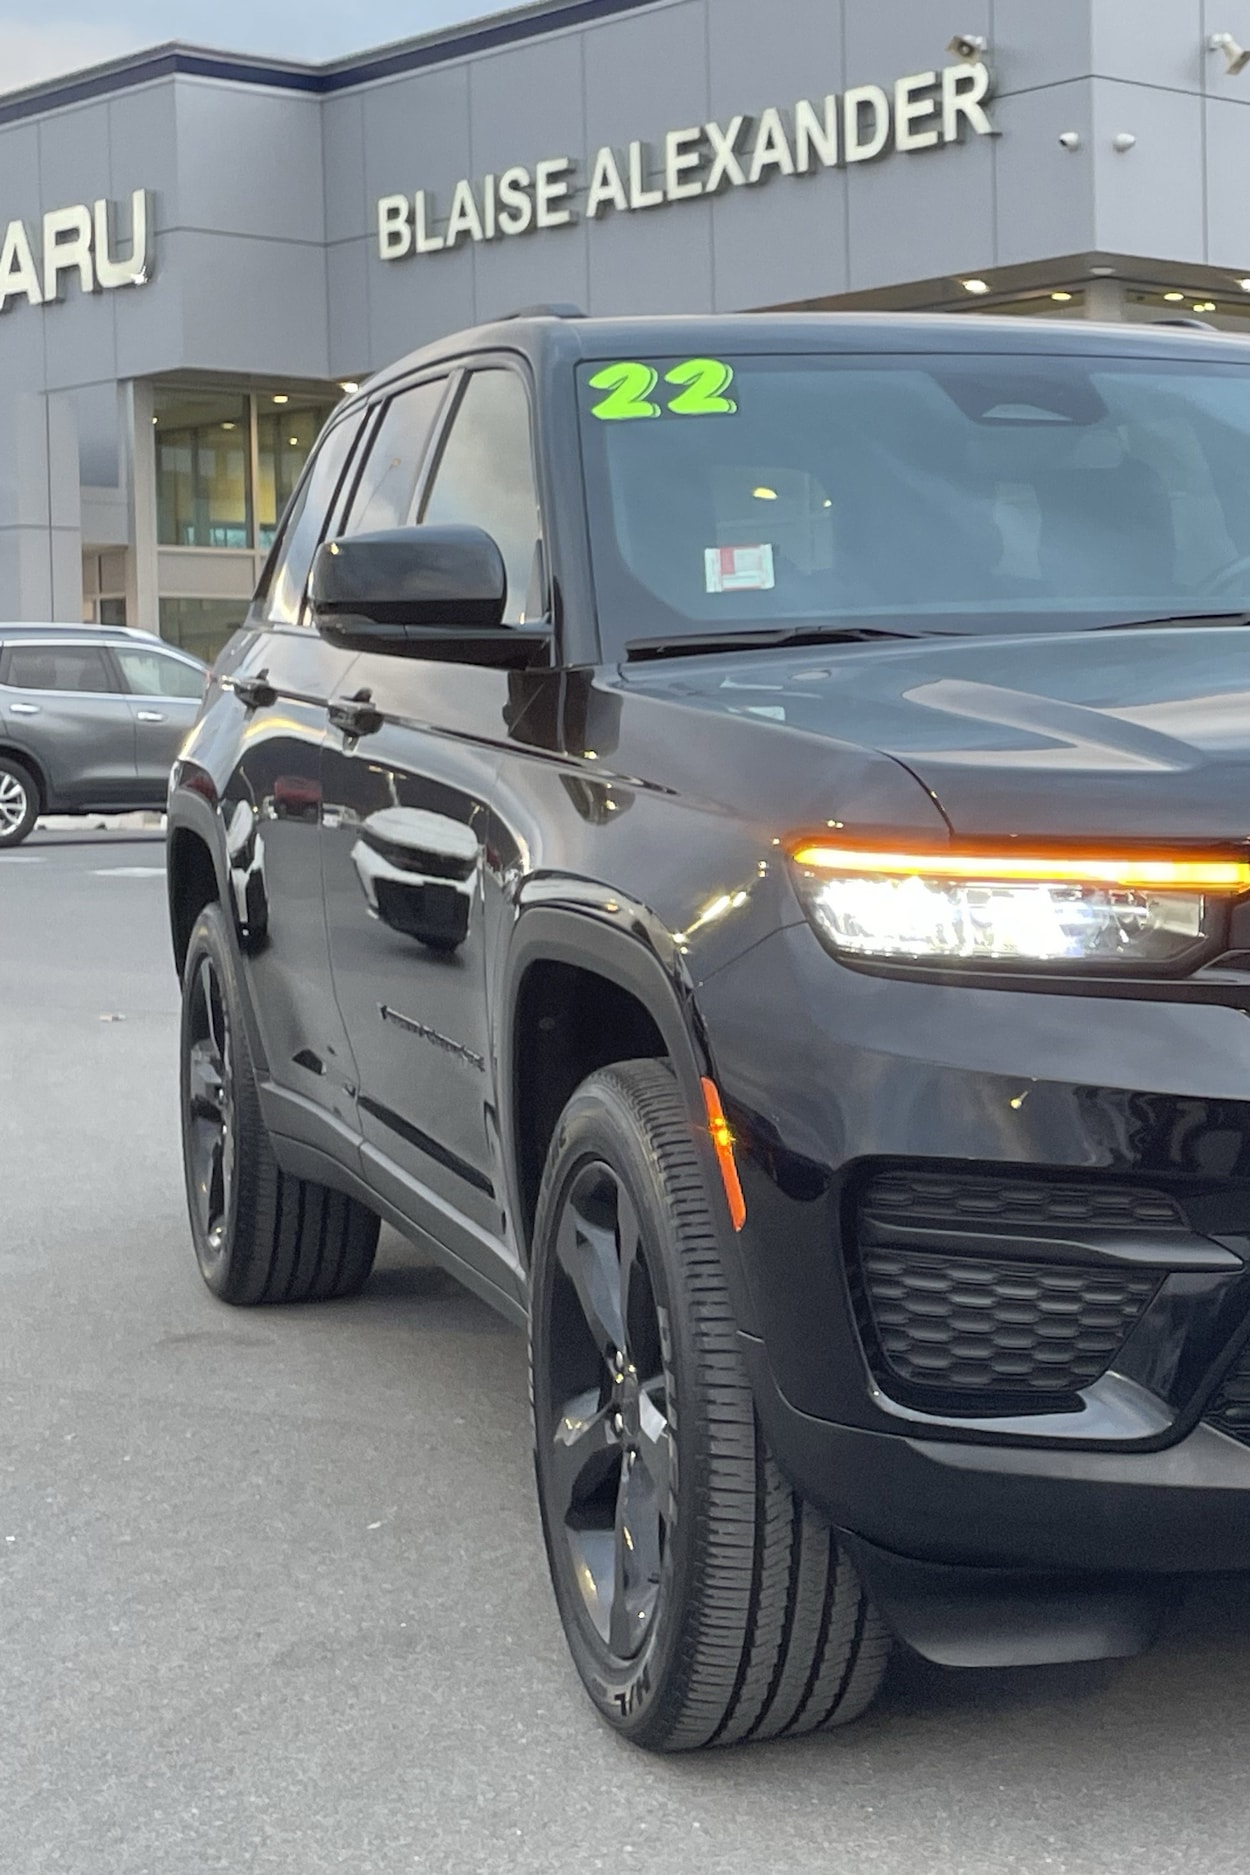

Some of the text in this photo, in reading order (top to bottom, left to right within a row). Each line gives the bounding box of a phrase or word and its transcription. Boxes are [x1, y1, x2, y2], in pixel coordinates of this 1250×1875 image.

[378, 61, 993, 260] BLAISE ALEXANDER
[0, 188, 147, 312] ARU
[588, 357, 738, 421] 22
